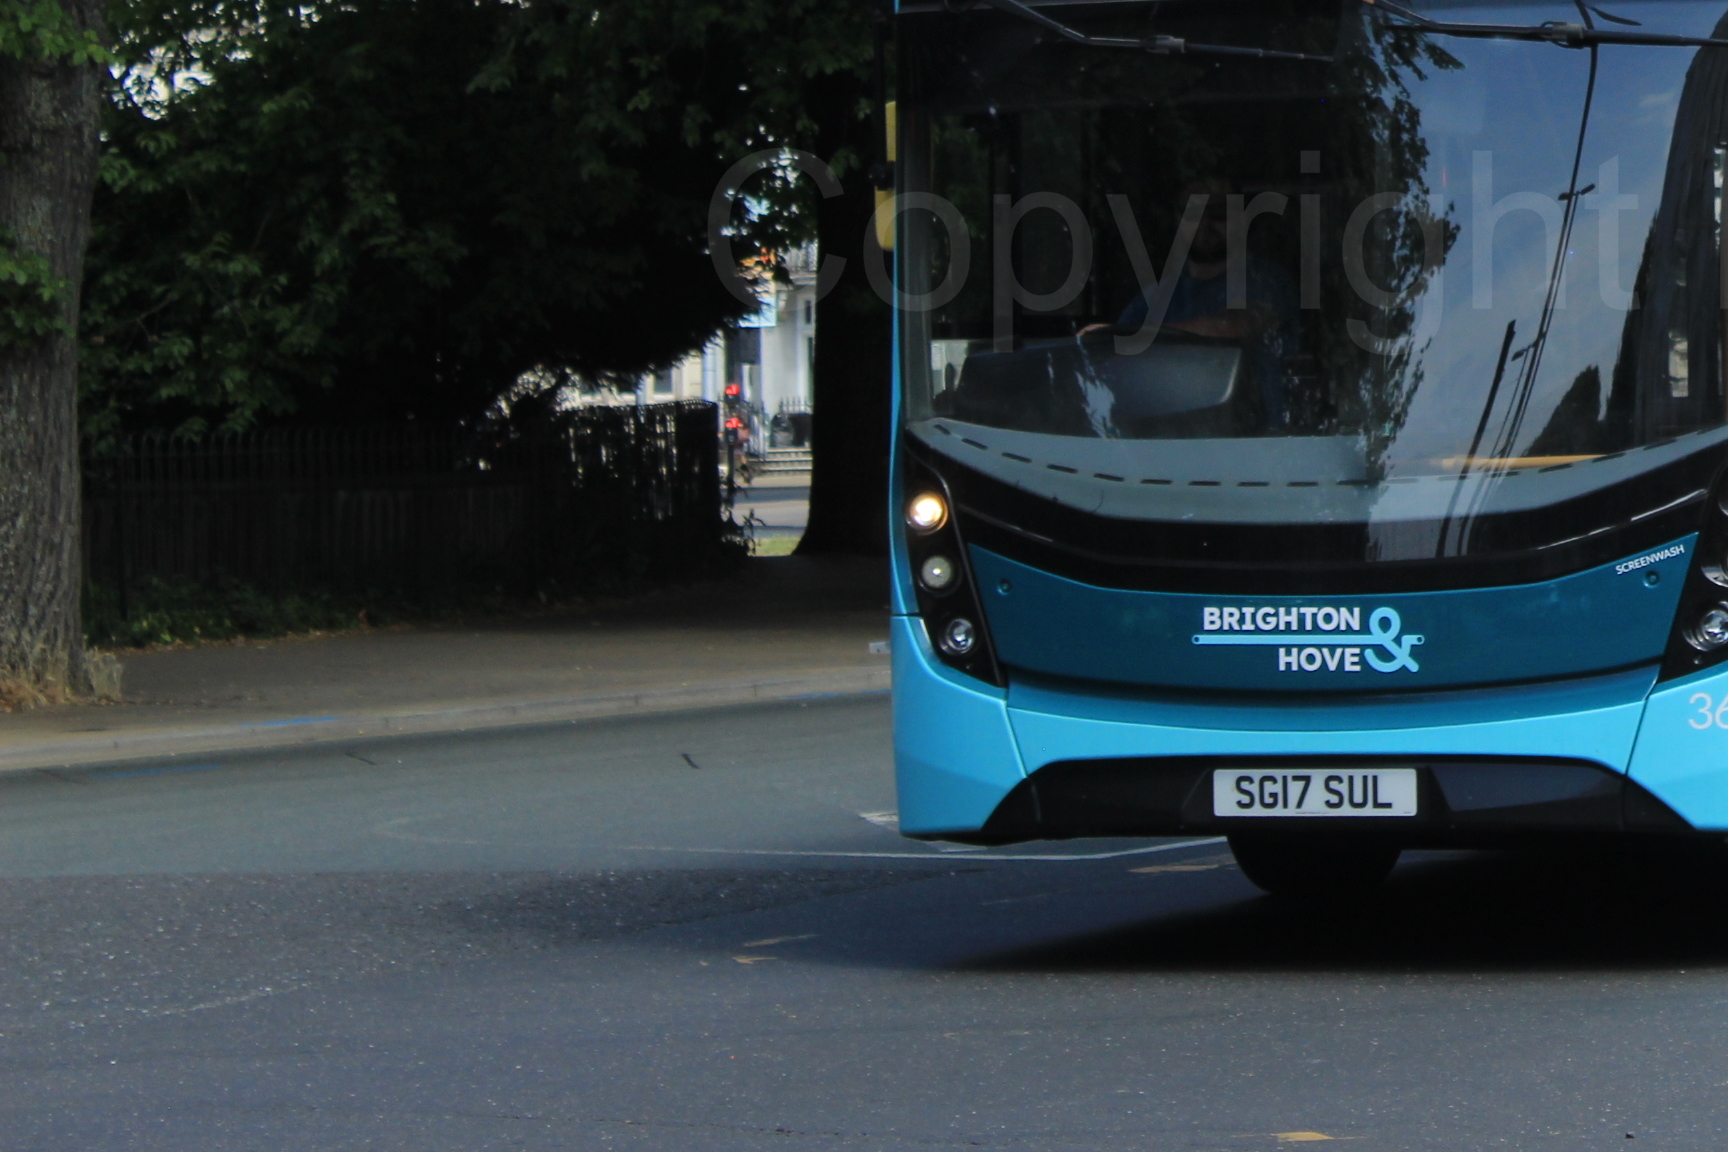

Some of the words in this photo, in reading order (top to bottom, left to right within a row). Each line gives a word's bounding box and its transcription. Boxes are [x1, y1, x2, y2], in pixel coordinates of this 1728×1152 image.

[1614, 544, 1685, 575] SCREENWASH
[1203, 606, 1361, 631] BRIGHTON
[1278, 647, 1362, 672] HOVE
[1235, 774, 1312, 810] SG17
[1323, 774, 1393, 810] SUL
